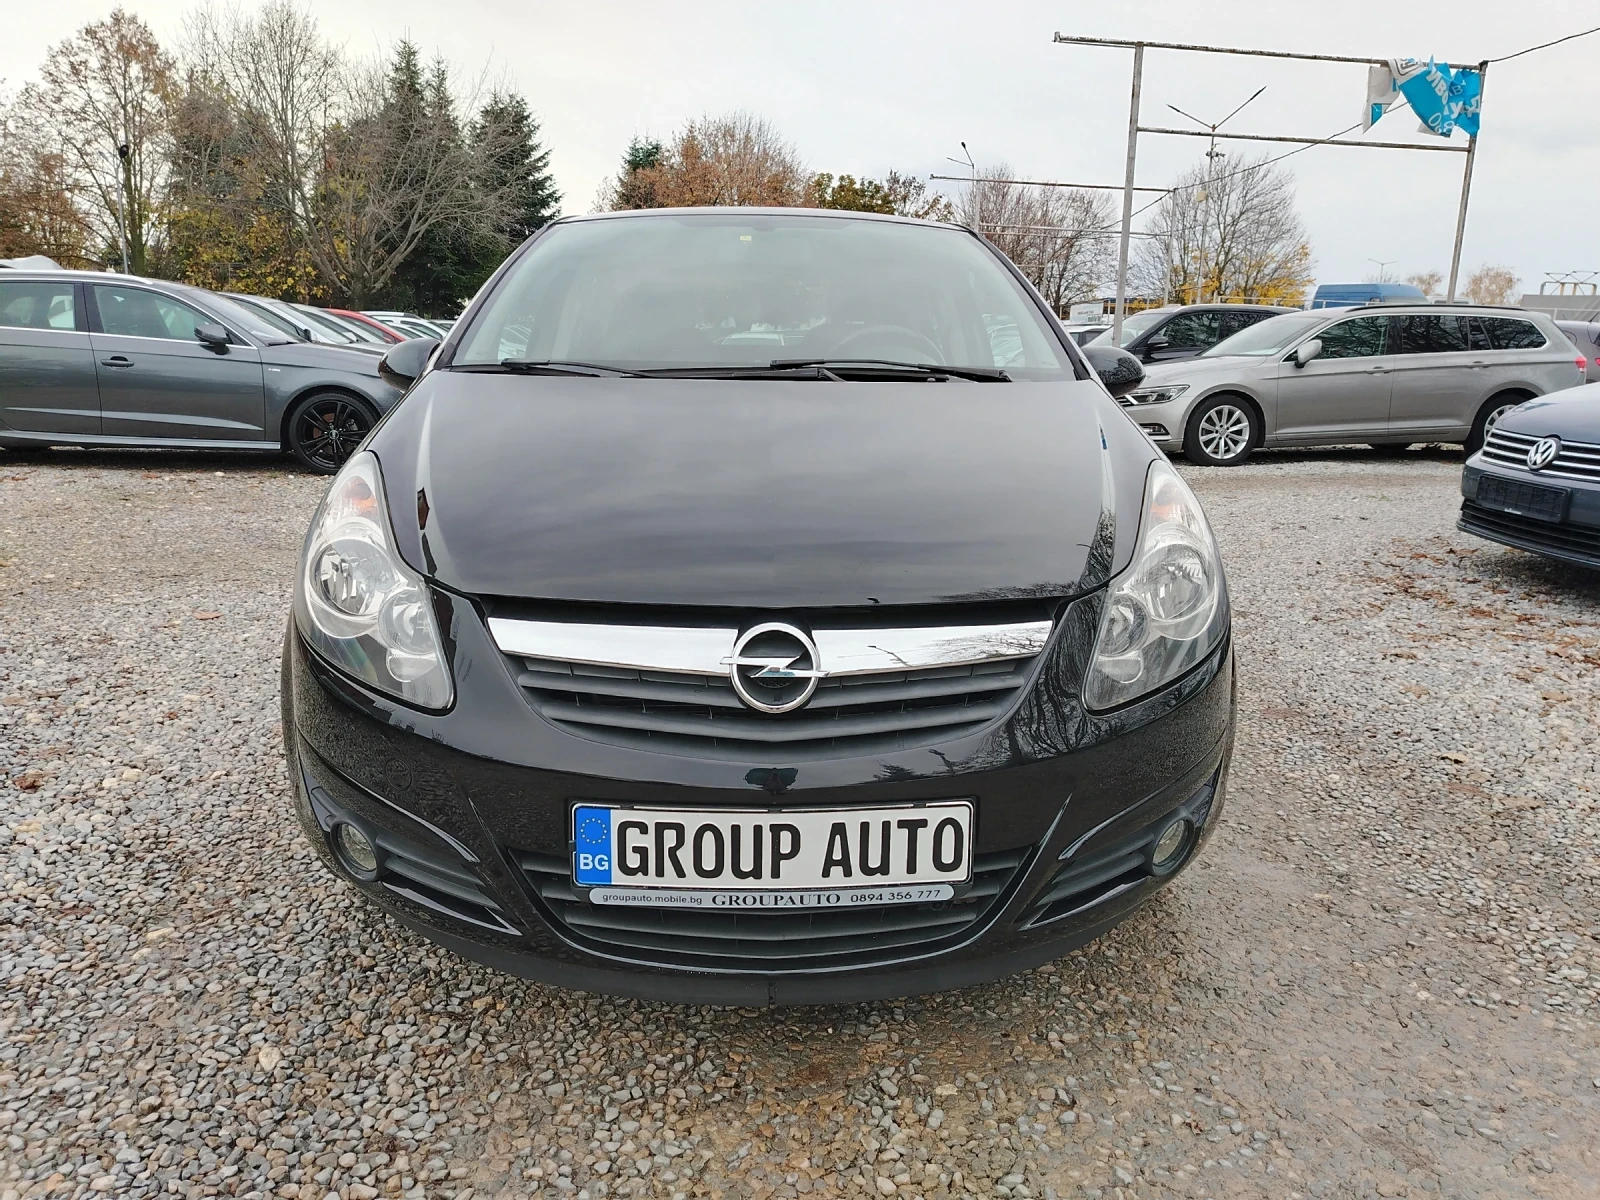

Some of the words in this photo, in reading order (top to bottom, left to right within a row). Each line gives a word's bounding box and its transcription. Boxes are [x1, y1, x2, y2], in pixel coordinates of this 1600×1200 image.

[617, 820, 801, 880] GROUP
[821, 817, 964, 878] AUTO
[579, 853, 609, 870] BG
[602, 893, 702, 905] groupauto.mobile.bg
[711, 893, 841, 906] GROUPAUTO
[850, 893, 884, 903] 0894
[887, 891, 913, 901] 356
[917, 889, 941, 899] 777
